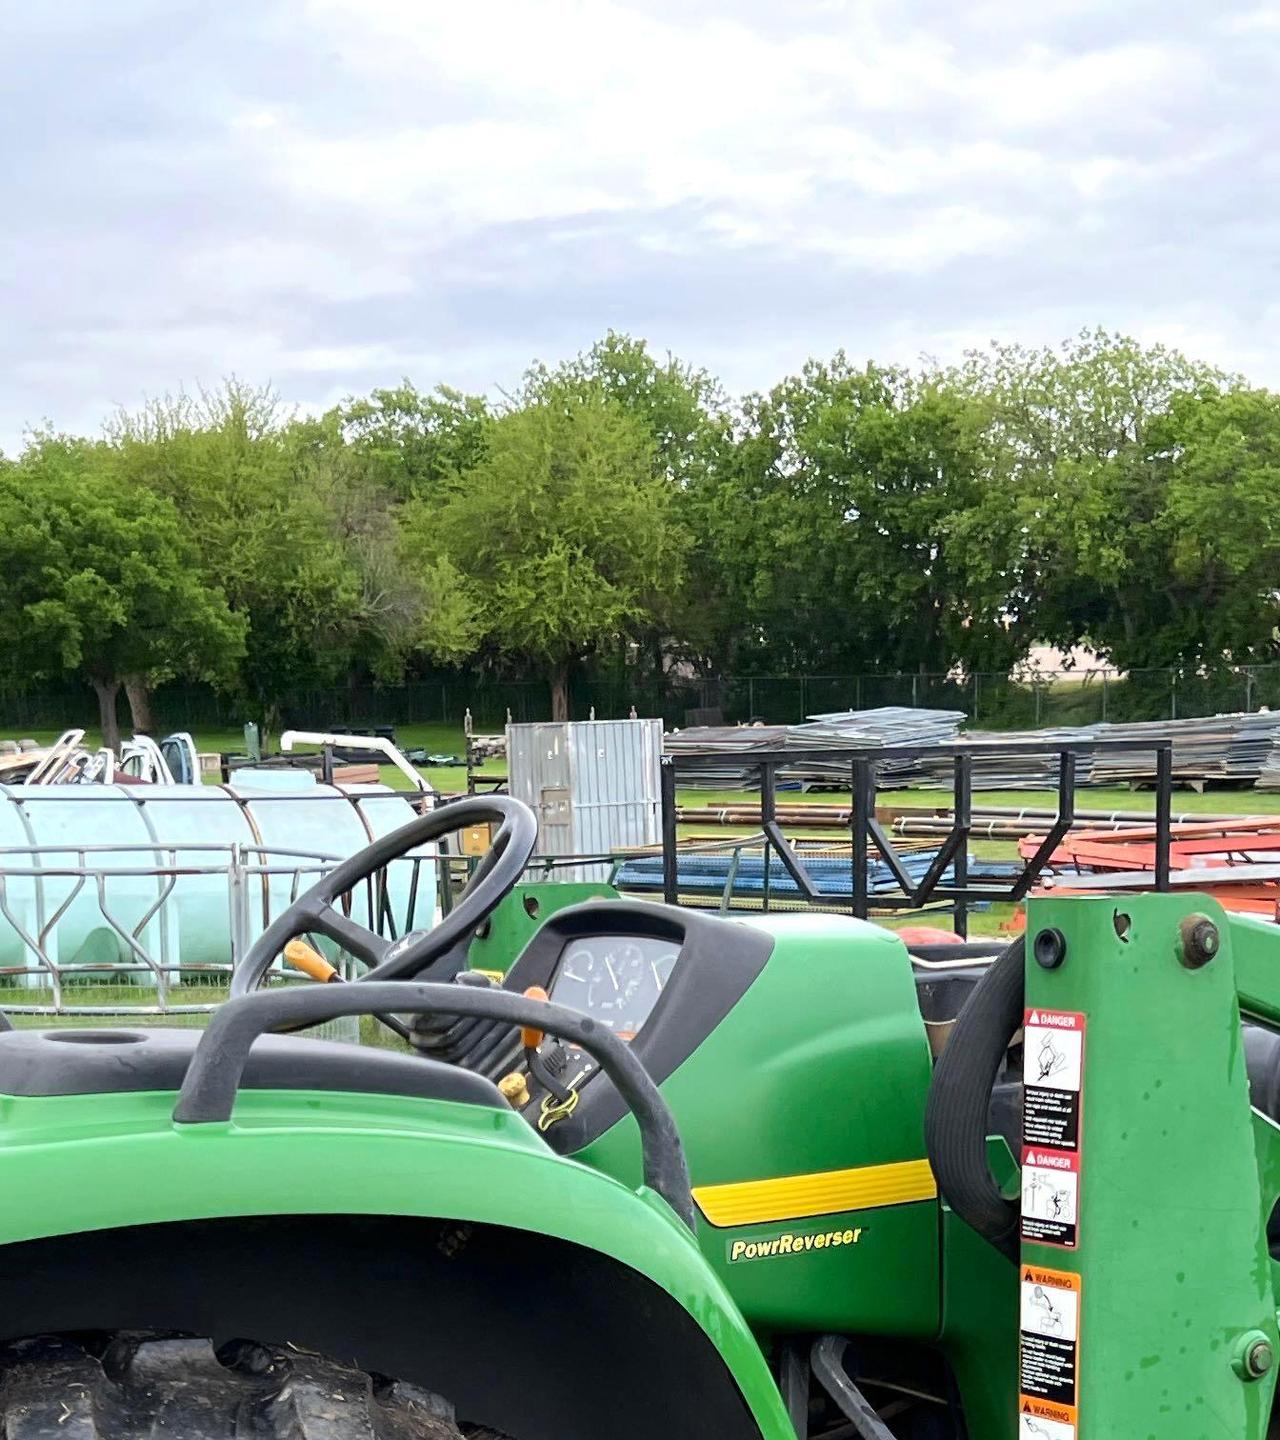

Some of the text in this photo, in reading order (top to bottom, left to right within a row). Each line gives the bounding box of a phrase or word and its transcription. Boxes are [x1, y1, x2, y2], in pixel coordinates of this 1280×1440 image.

[1040, 1014, 1076, 1027] DANGER
[1036, 1154, 1071, 1168] DANGER
[730, 1227, 862, 1262] PowrReverser
[1034, 1273, 1072, 1289] WARNING
[1033, 1405, 1070, 1422] WARNING
